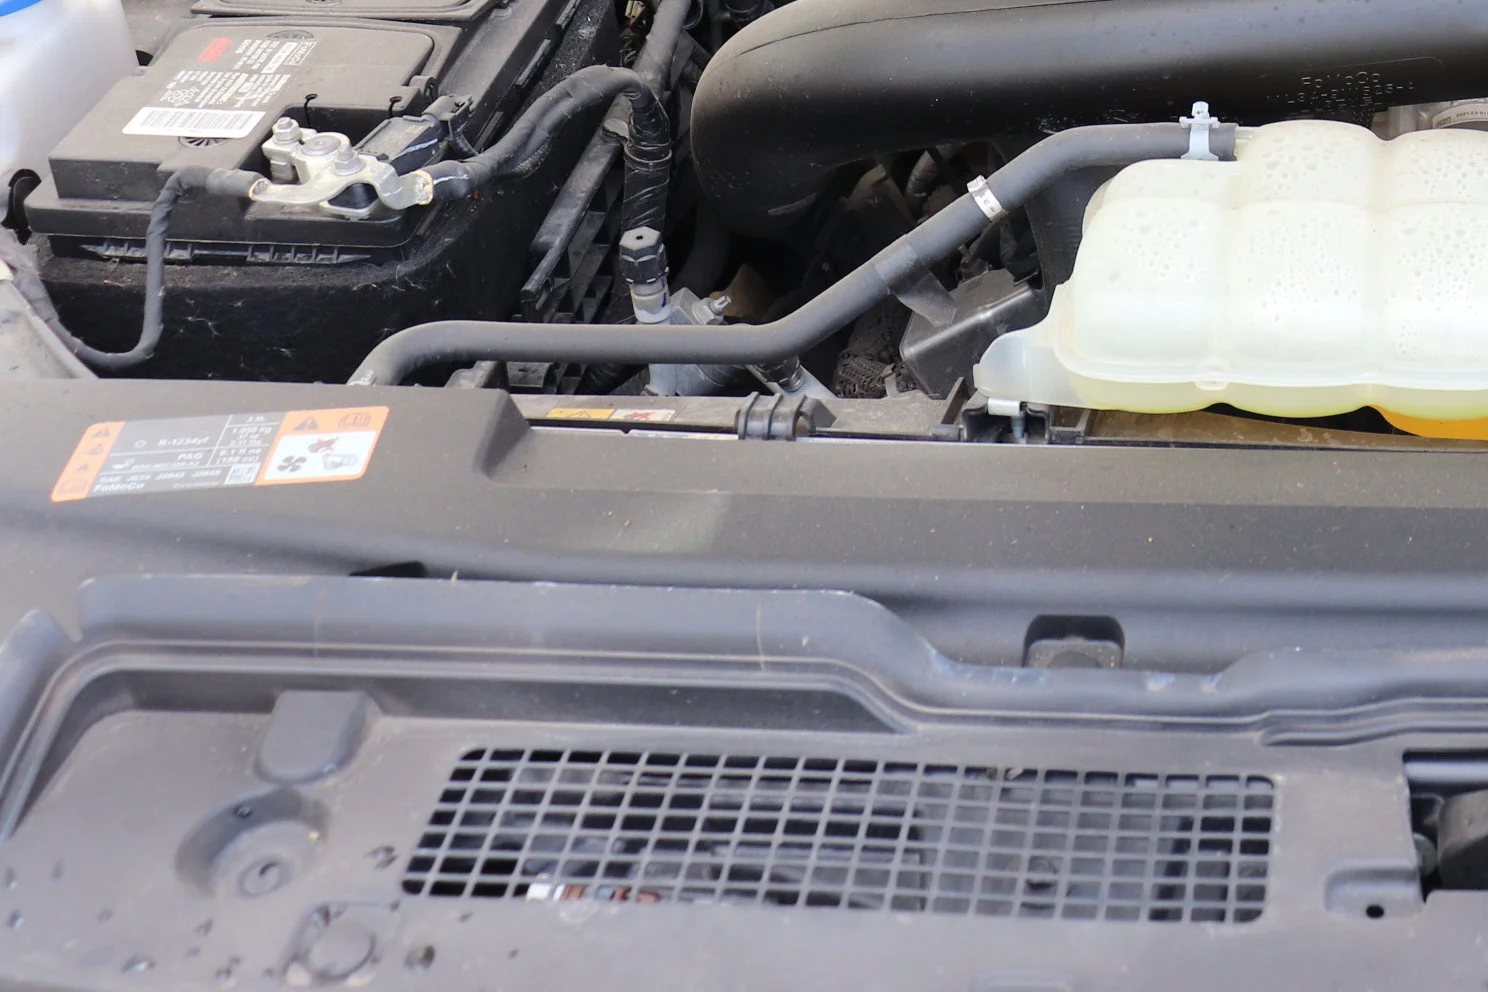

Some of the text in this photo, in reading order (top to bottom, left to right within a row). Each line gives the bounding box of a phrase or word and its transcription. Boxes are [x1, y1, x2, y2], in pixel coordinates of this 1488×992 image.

[1301, 71, 1381, 89] FoMoCo
[157, 436, 210, 447] R-1234yf
[177, 452, 205, 461] PAG
[92, 482, 146, 492] FoMoCo
